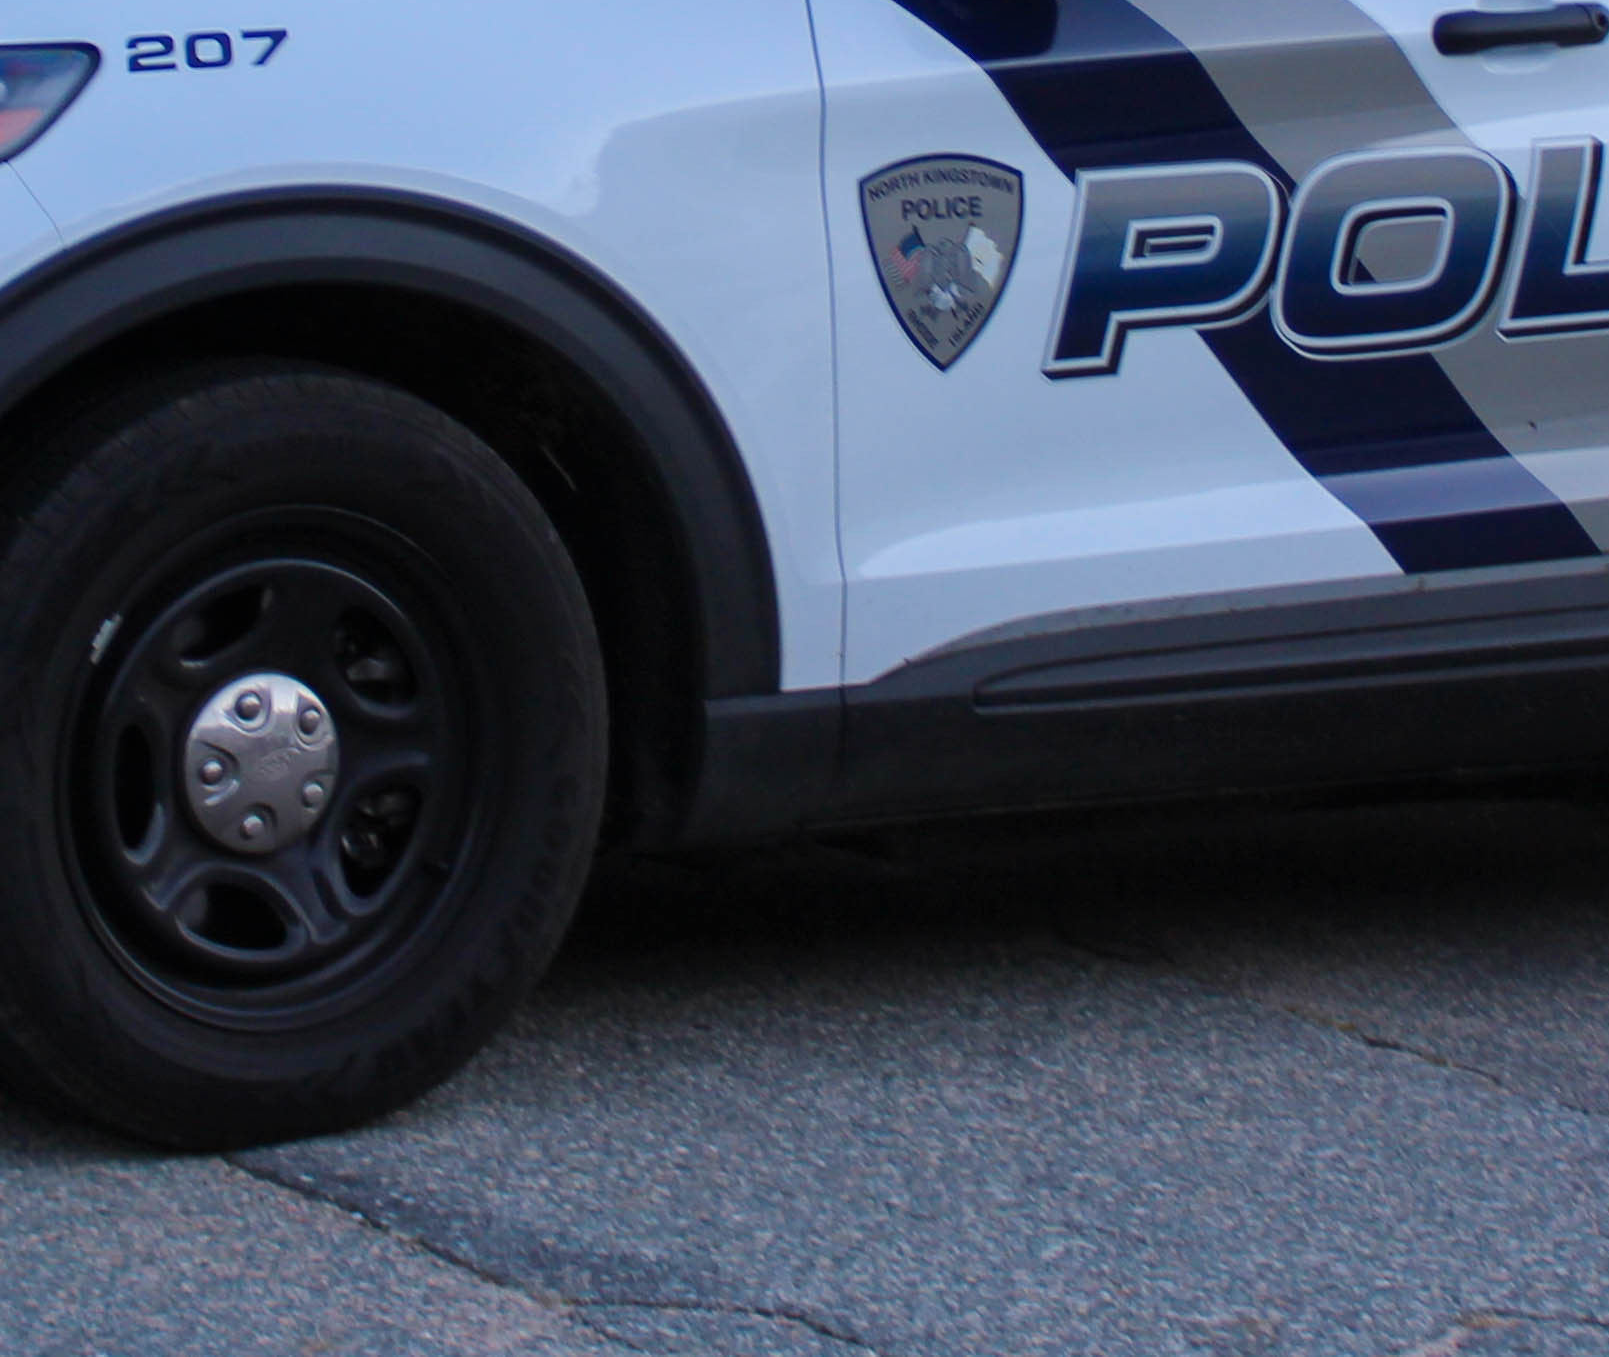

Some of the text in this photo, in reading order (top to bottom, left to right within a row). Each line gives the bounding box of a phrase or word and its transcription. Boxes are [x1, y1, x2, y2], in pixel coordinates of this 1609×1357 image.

[125, 28, 289, 72] 207
[867, 168, 1015, 202] NORTH KINGSTOWN
[901, 195, 984, 221] POLICE
